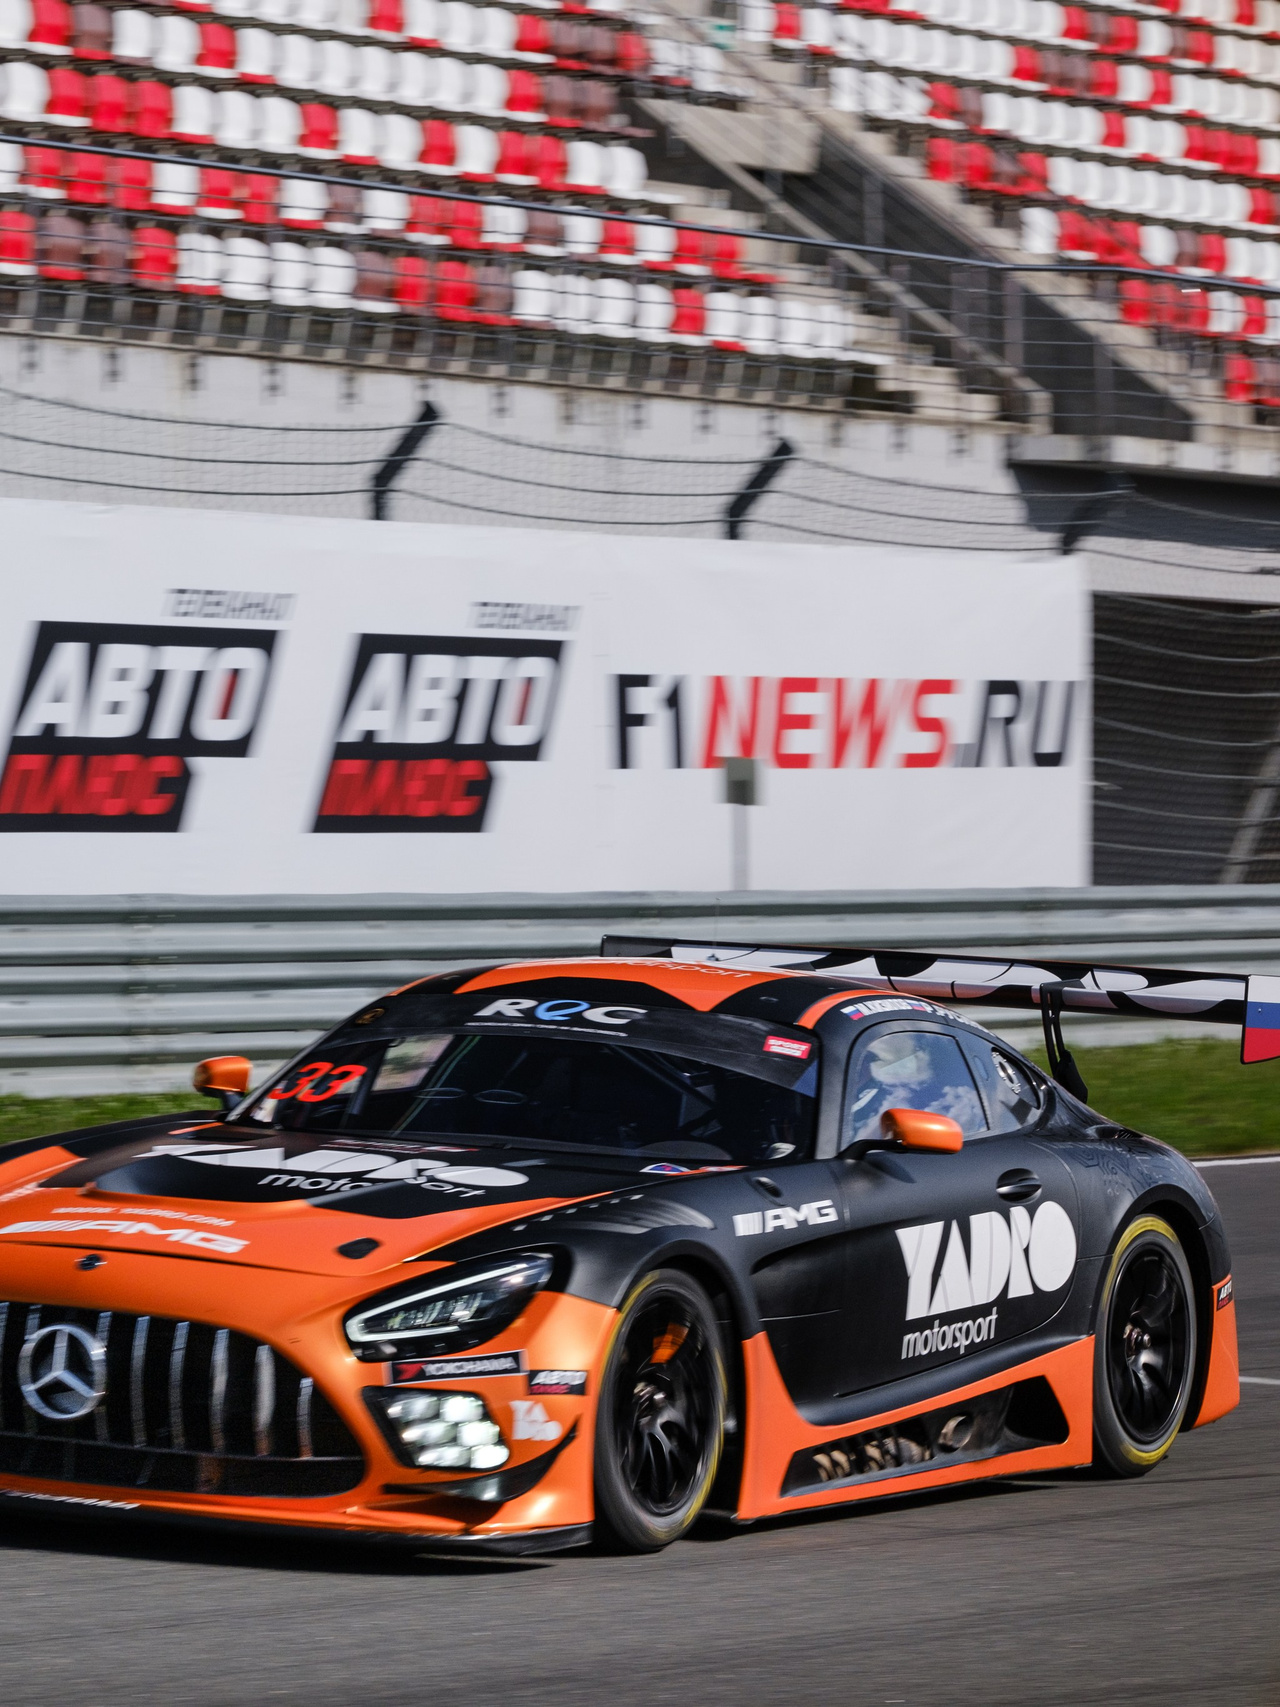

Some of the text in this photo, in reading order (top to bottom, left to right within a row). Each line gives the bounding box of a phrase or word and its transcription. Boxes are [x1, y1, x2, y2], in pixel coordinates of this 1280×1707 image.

[13, 641, 272, 741] АВТО
[334, 652, 561, 746] АВТО
[609, 674, 1082, 769] F1NEWS.RU
[267, 1061, 368, 1102] 33
[62, 1219, 251, 1254] AMG
[763, 1199, 838, 1233] AMG
[895, 1200, 1077, 1321] YADRO
[901, 1306, 998, 1360] motorsport
[422, 1356, 518, 1376] YOKOHAMA
